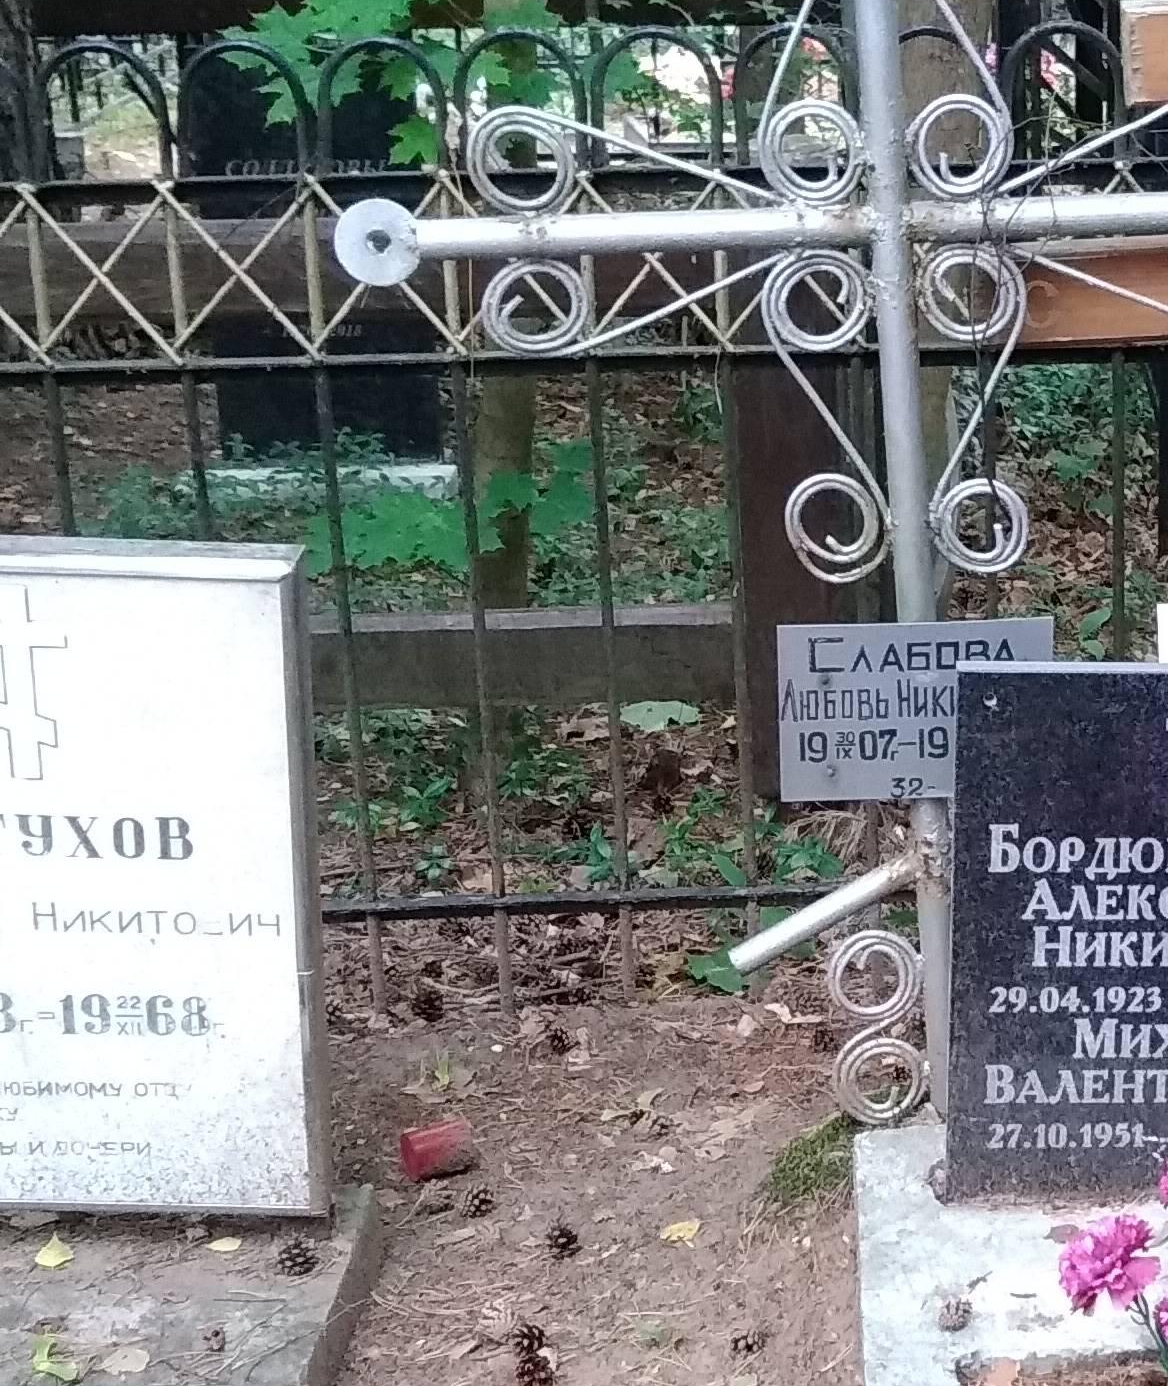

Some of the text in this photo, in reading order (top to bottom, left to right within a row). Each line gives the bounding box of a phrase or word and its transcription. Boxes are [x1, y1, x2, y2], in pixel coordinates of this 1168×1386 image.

[0, 813, 195, 861] УХОВ
[988, 986, 1162, 1013] 29.04.1923
[986, 1122, 1145, 1149] 27.10.1951
